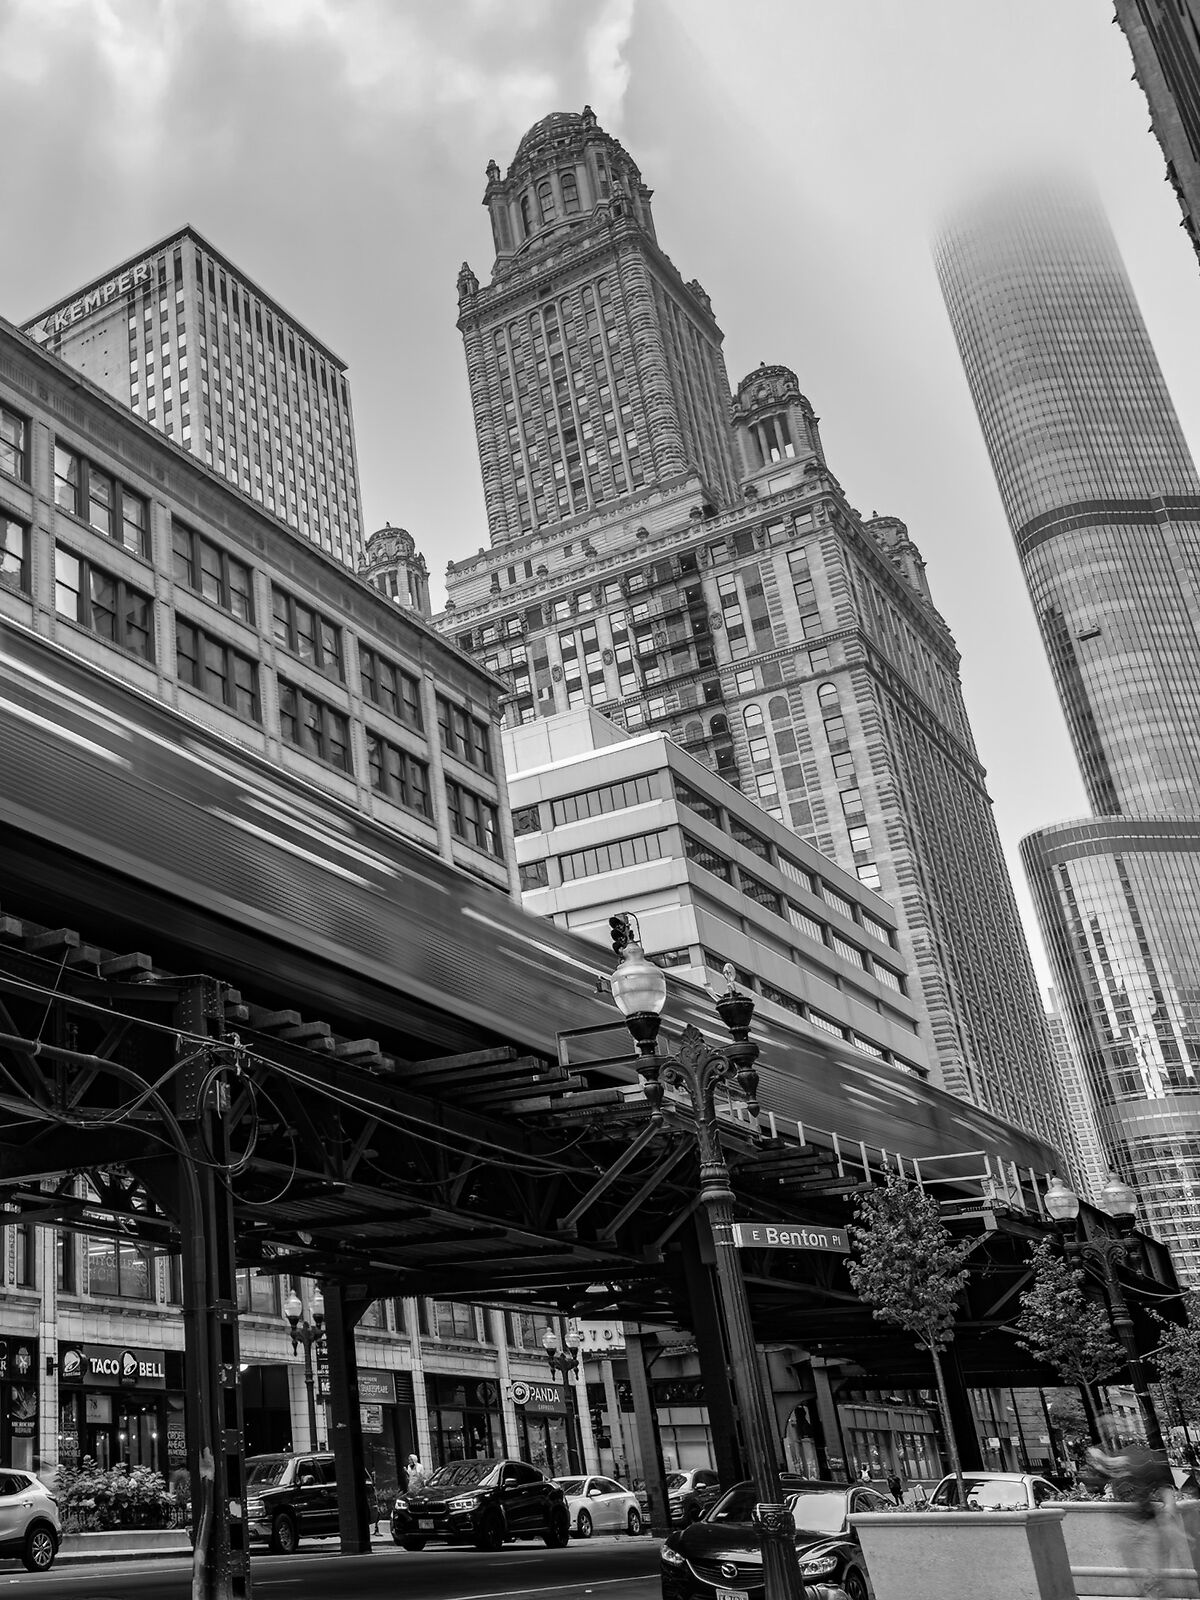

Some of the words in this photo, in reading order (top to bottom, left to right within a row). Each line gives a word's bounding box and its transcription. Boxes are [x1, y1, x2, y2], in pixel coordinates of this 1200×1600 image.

[54, 263, 149, 332] KEMPER
[752, 1230, 761, 1241] E
[765, 1227, 828, 1247] Benton
[832, 1235, 841, 1246] Pl
[89, 1358, 120, 1375] TACO
[139, 1362, 165, 1378] BELL
[529, 1386, 561, 1403] PANDA
[167, 1431, 185, 1440] ORDER
[167, 1440, 186, 1449] AHEAD
